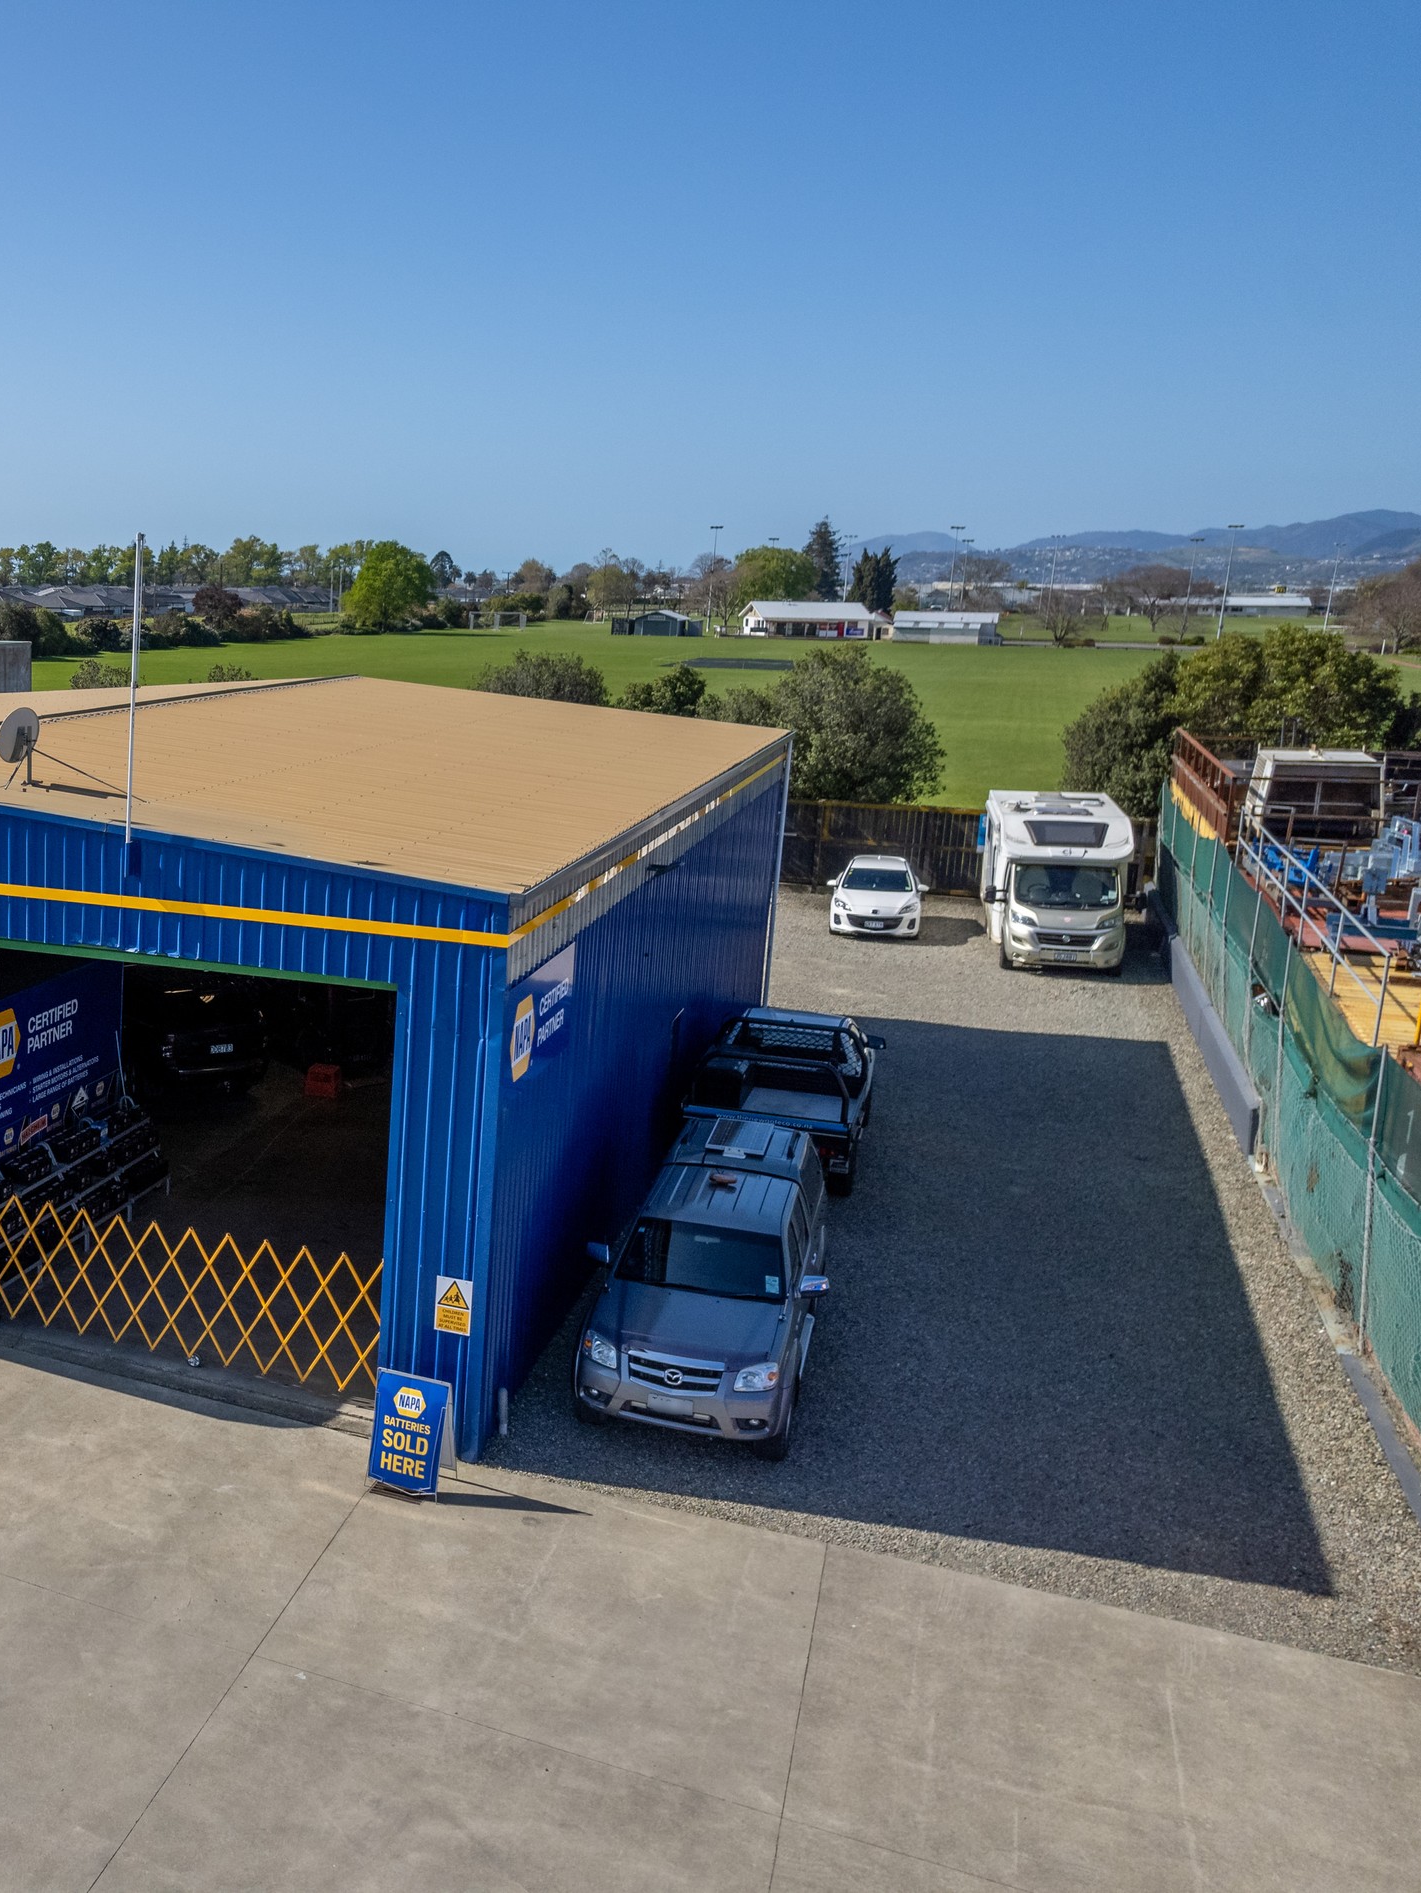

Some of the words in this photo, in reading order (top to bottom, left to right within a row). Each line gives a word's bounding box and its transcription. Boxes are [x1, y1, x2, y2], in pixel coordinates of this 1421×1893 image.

[539, 977, 569, 1017] CERTIFIED
[27, 998, 78, 1034] CERTIFIED
[536, 1007, 565, 1048] PARTNER
[27, 1020, 73, 1054] PARTNER
[514, 1014, 532, 1062] NAPA
[398, 1394, 420, 1411] NAPA
[381, 1428, 429, 1456] SOLD
[383, 1415, 431, 1435] BATTERIES
[380, 1451, 426, 1479] HERE
